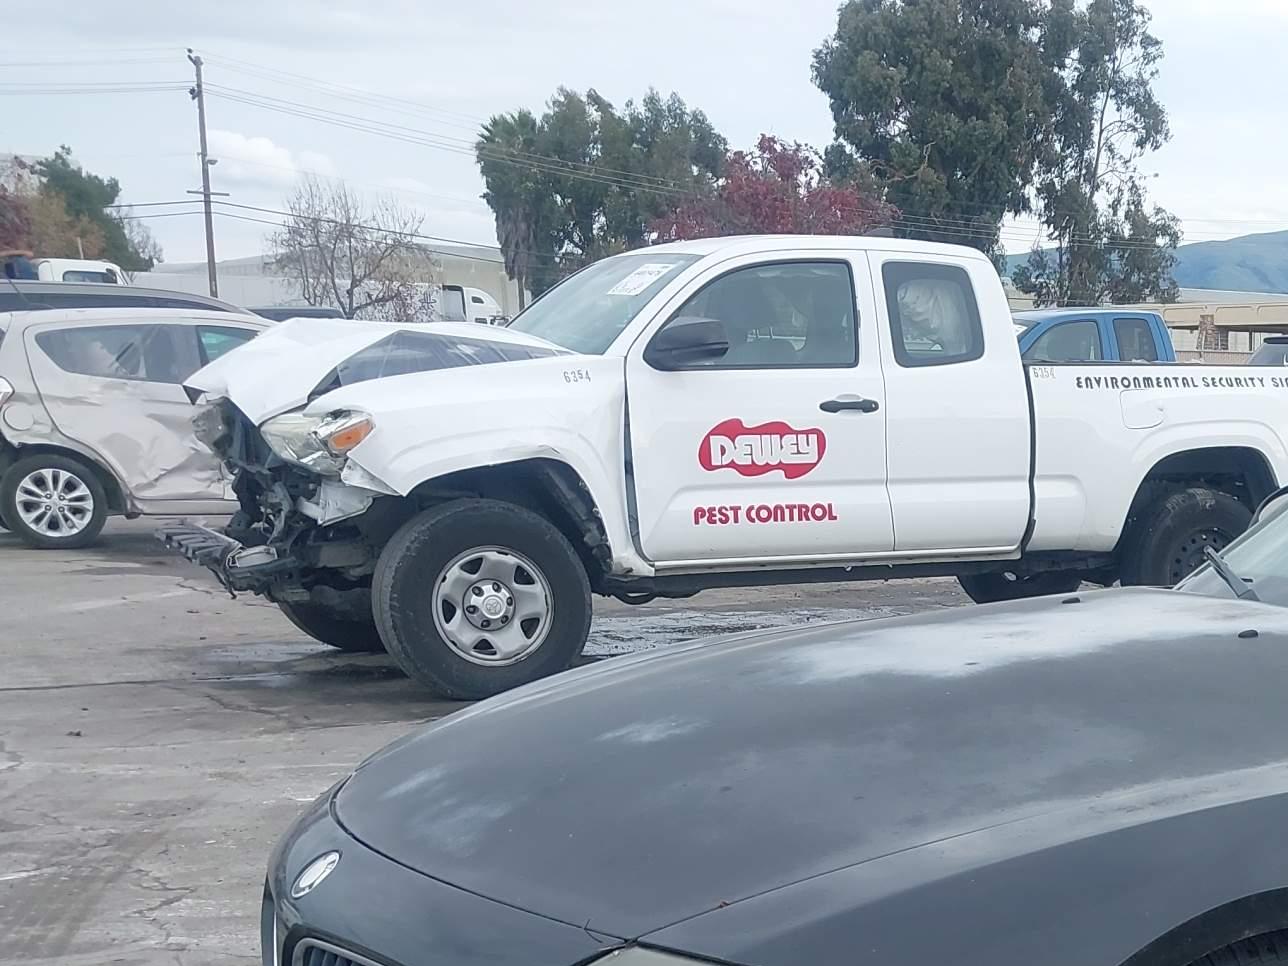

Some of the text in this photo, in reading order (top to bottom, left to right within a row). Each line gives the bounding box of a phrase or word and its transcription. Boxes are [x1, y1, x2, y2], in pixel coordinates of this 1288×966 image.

[563, 369, 591, 383] 6354
[1075, 375, 1198, 390] ENVIRONMENTAL
[1202, 376, 1265, 388] SECURITY
[709, 433, 819, 466] DEWEY
[693, 502, 838, 525] PEST CONTROL
